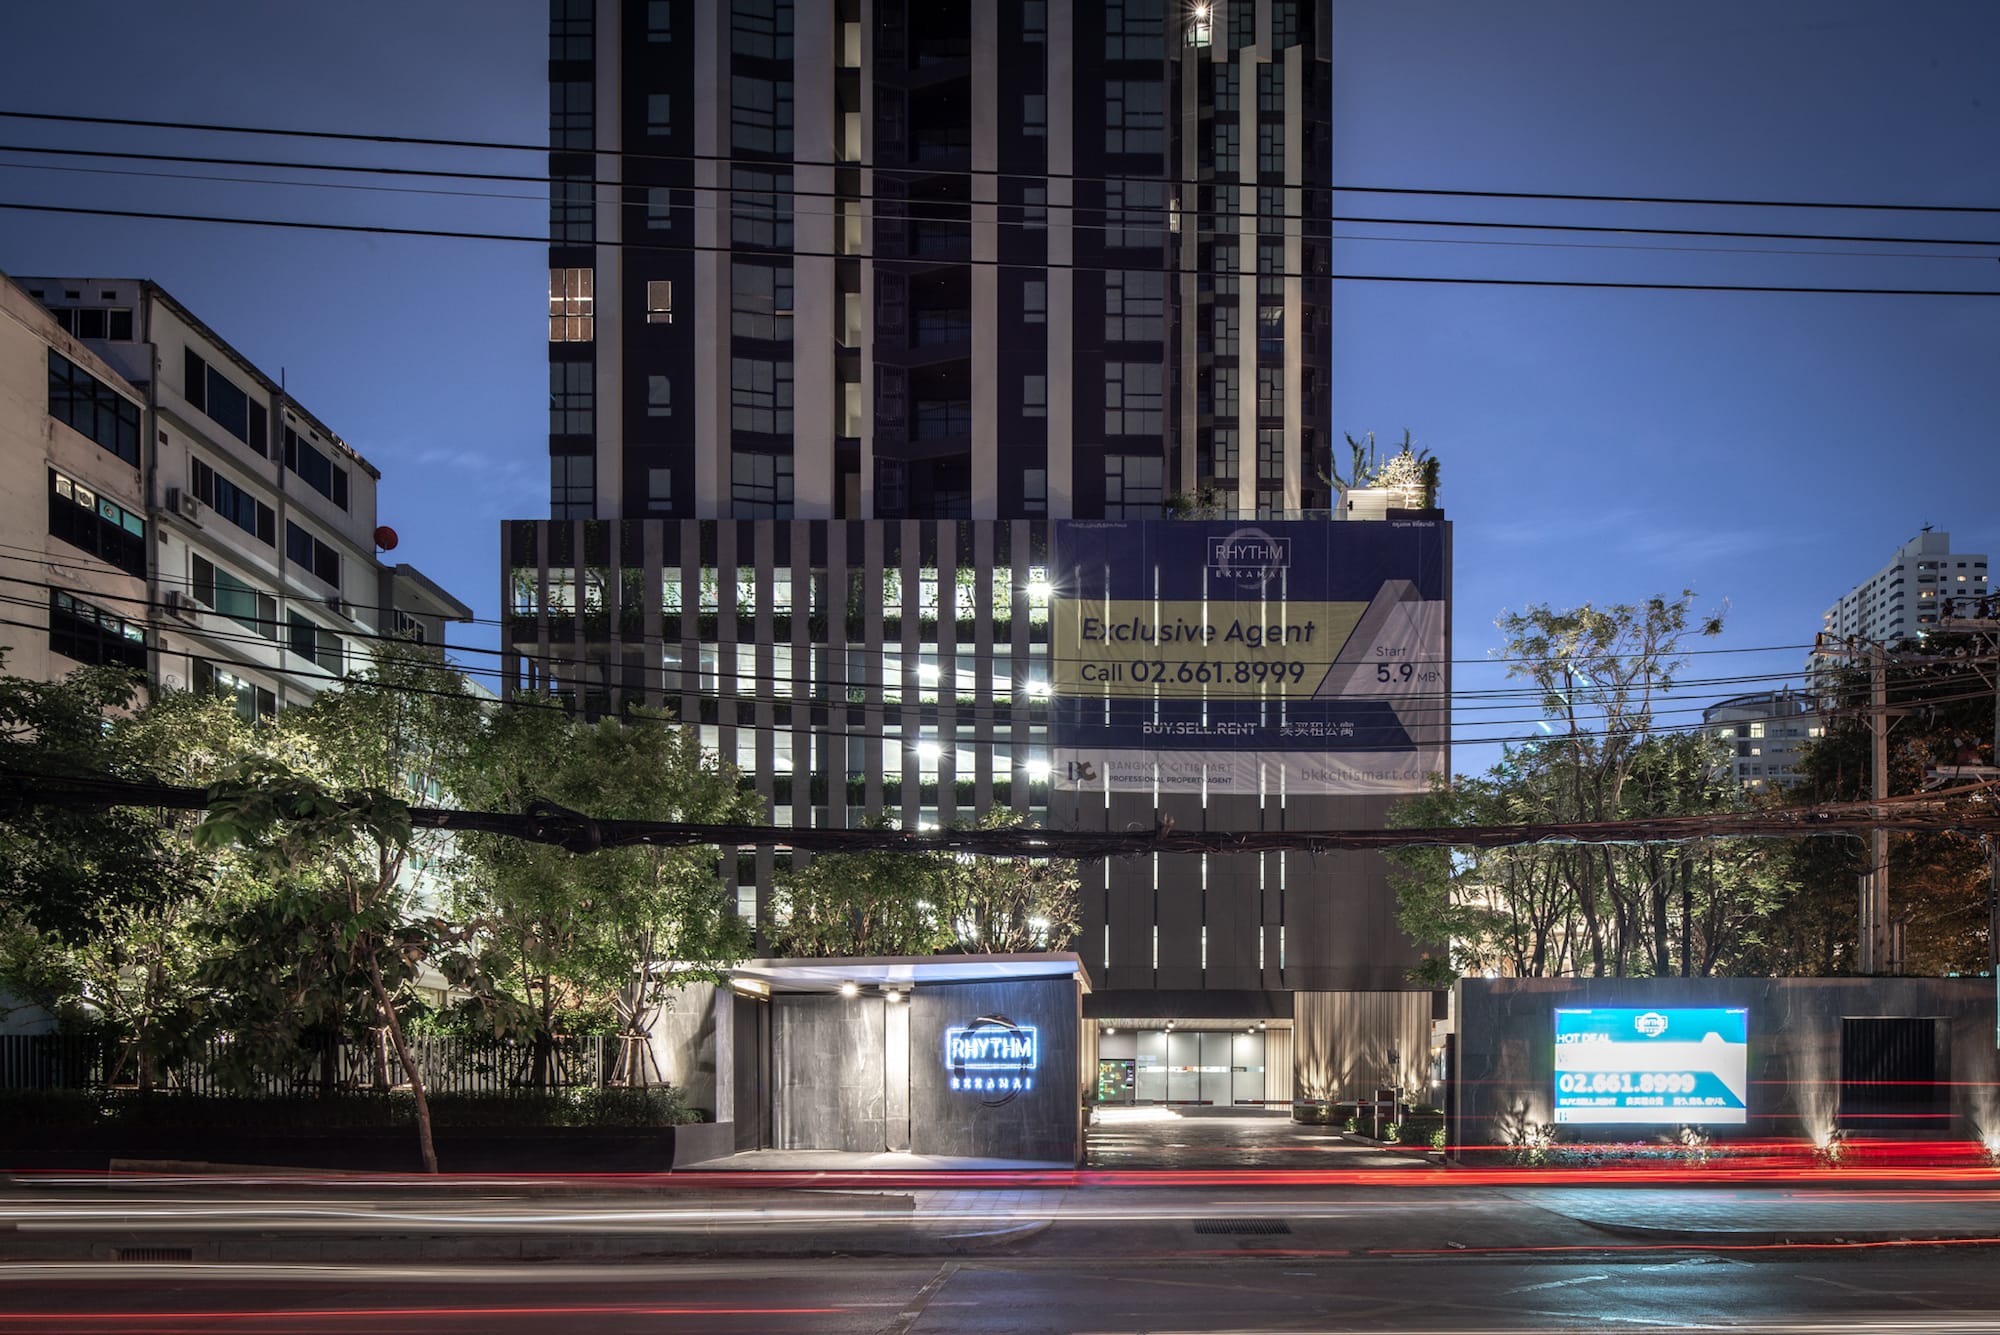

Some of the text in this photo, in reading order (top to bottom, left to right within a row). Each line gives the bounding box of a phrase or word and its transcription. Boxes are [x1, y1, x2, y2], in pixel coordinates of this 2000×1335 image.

[1215, 545, 1283, 559] RHYTHM
[1215, 570, 1285, 578] EKKAMAI
[1082, 617, 1315, 648] Exclusive Agent
[1376, 646, 1406, 657] Start
[1081, 660, 1305, 683] Call 02.661.8999
[1377, 662, 1413, 683] 5.9
[1142, 721, 1258, 735] BUY.SELL.RENT
[952, 1038, 1032, 1059] RHYTHM
[1559, 1073, 1696, 1093] 02.661.8999
